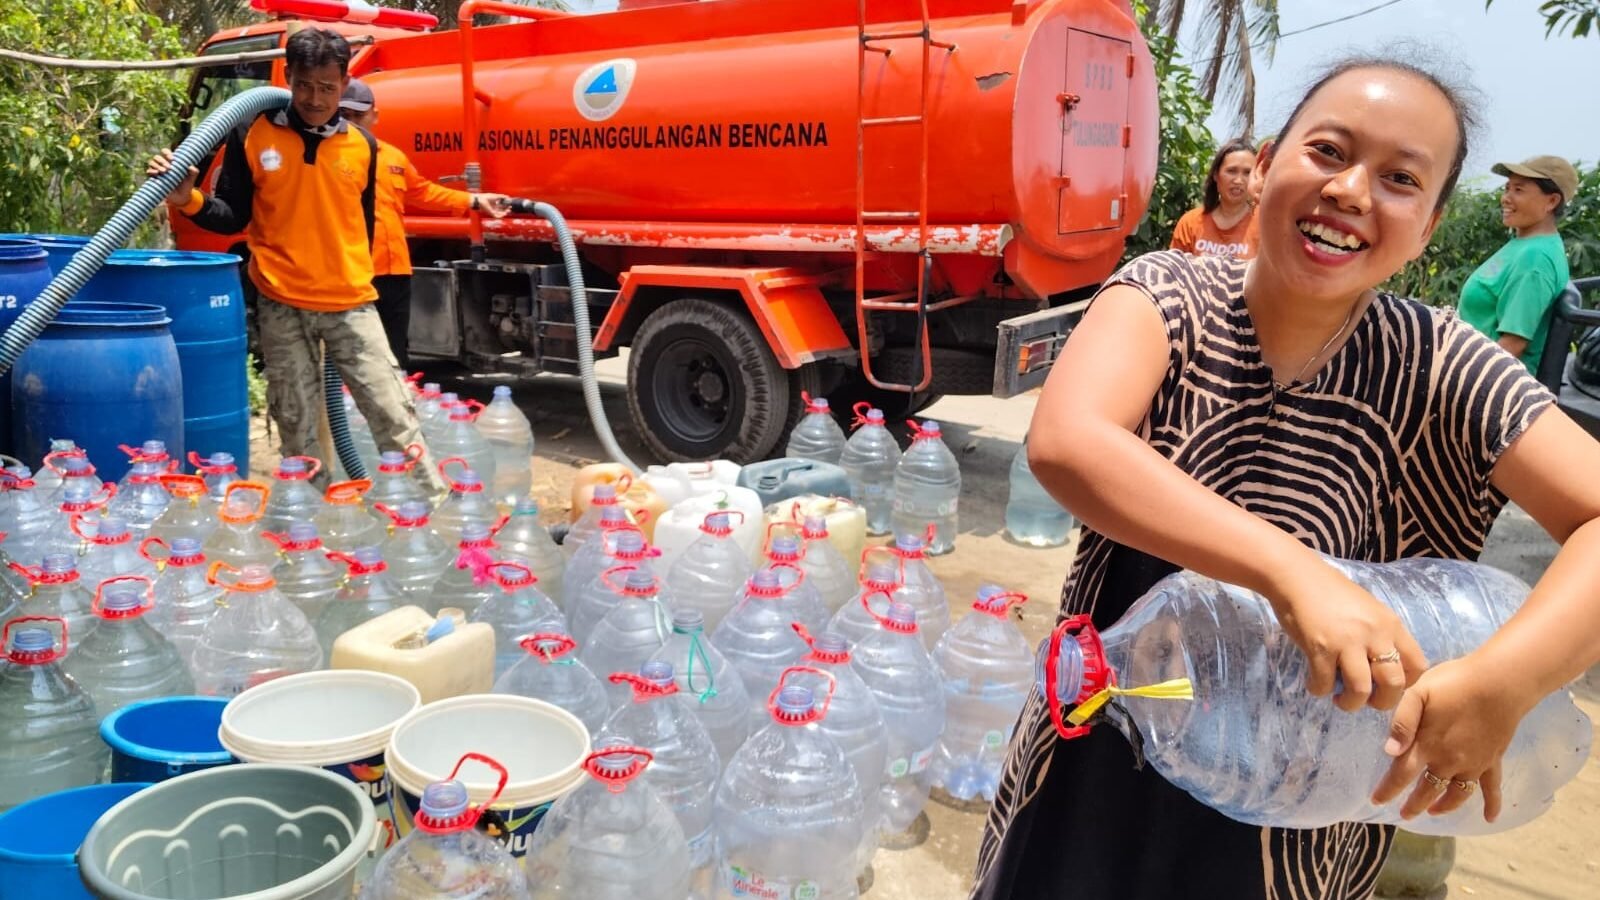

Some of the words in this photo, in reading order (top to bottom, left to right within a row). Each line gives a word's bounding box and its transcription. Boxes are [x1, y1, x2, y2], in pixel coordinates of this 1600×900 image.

[414, 131, 463, 152] BADAN
[478, 129, 545, 151] ASIONAL
[549, 124, 722, 150] PENANGGULANGAN
[728, 122, 828, 148] BENCANA
[1195, 239, 1249, 255] ONDON
